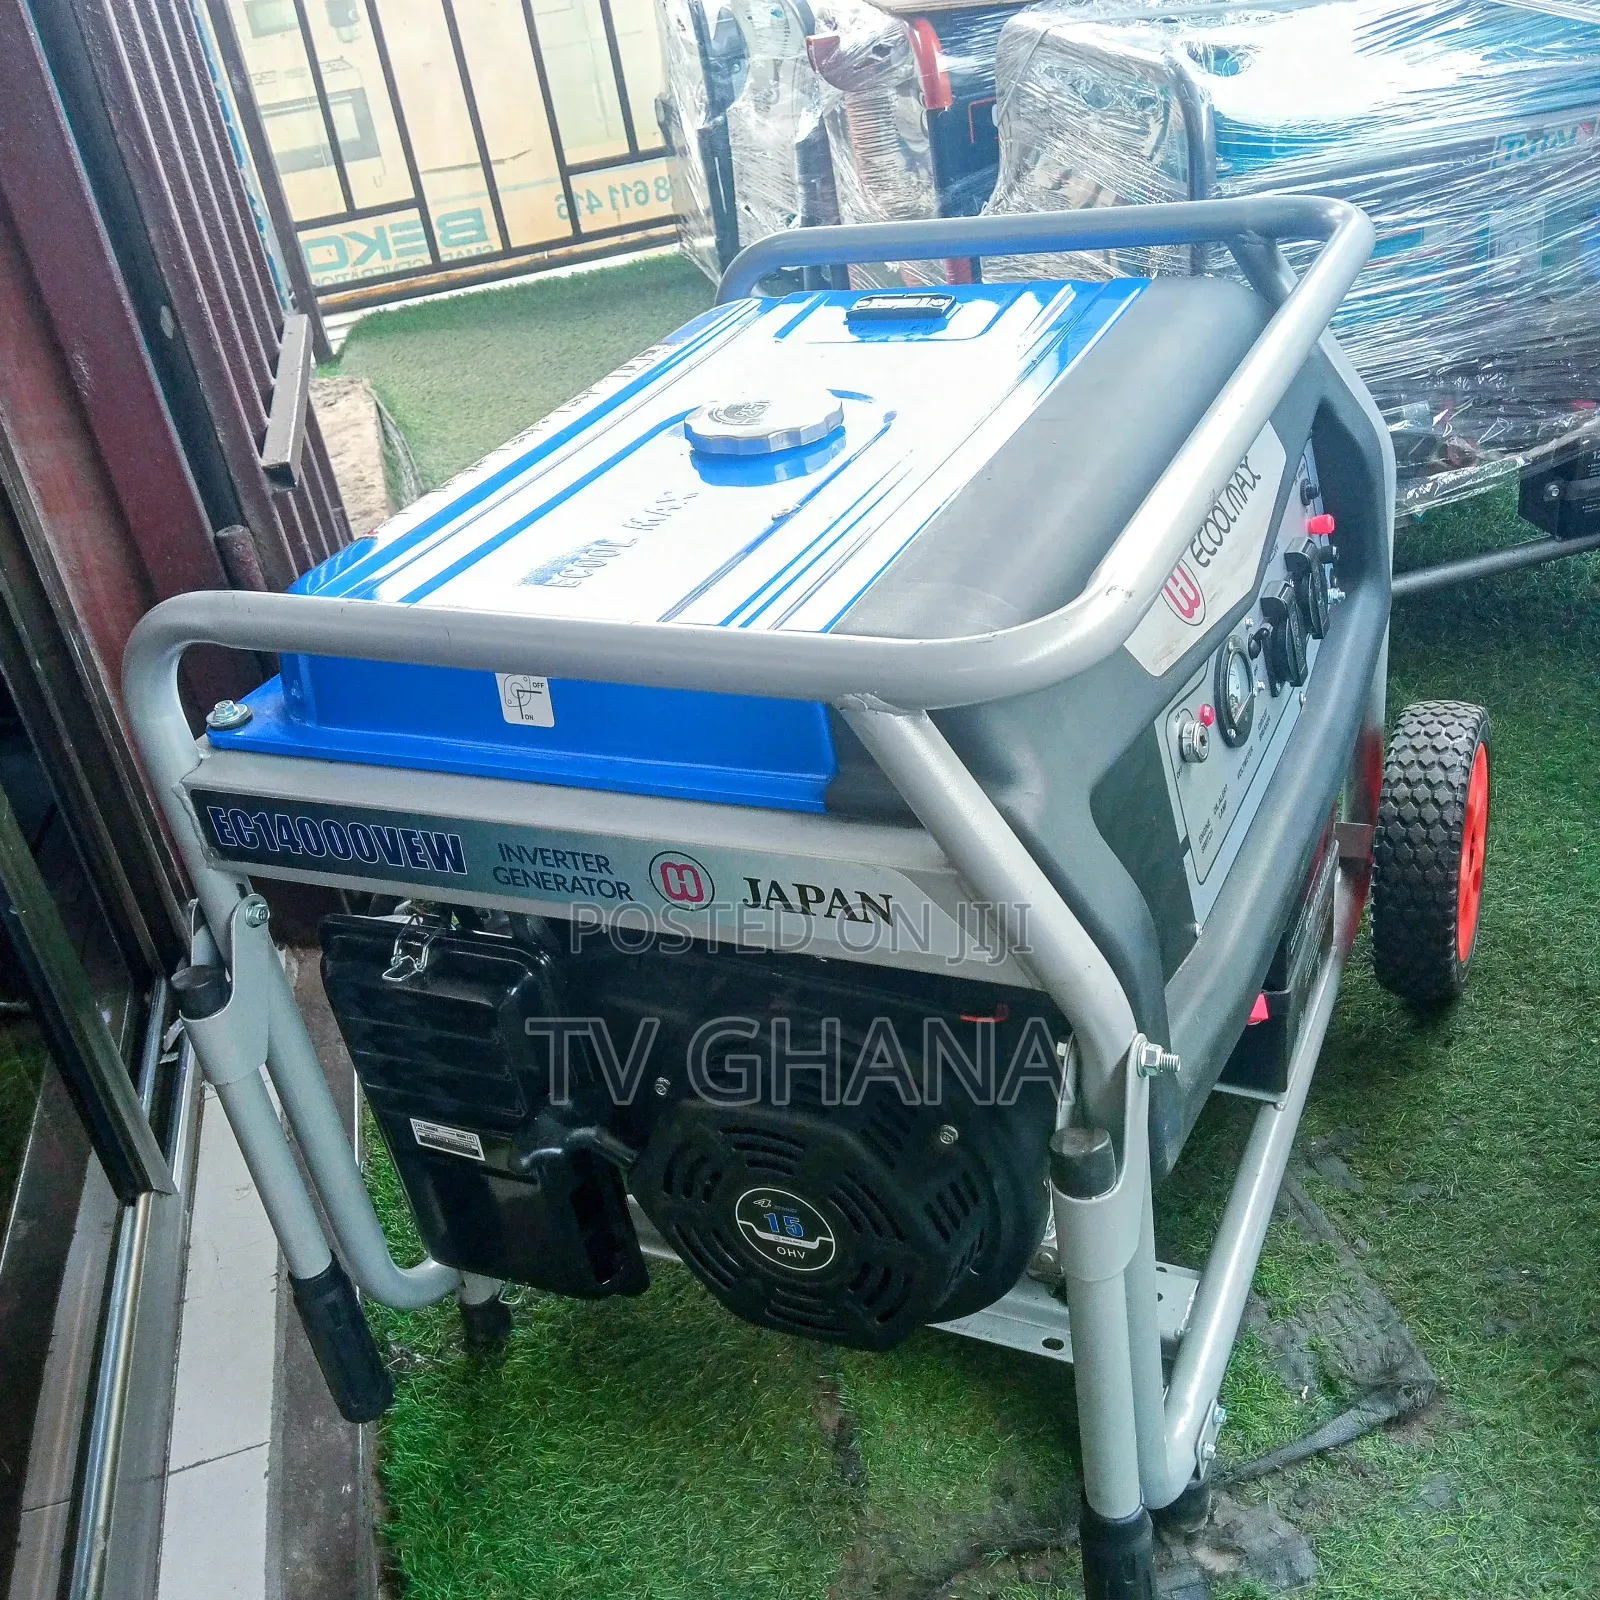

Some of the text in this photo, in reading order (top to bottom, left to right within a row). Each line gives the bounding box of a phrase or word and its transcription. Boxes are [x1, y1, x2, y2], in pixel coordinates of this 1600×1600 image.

[1189, 455, 1262, 568] ECOOLMAX
[532, 681, 545, 689] OFF
[524, 713, 535, 721] ON
[206, 805, 468, 876] EC14000VEW
[1198, 817, 1212, 845] ENGINE
[497, 842, 612, 876] INVERTER
[492, 865, 635, 902] GENERATOR
[742, 876, 894, 928] JAPAN
[763, 1212, 804, 1238] 15
[776, 1246, 806, 1260] OHV
